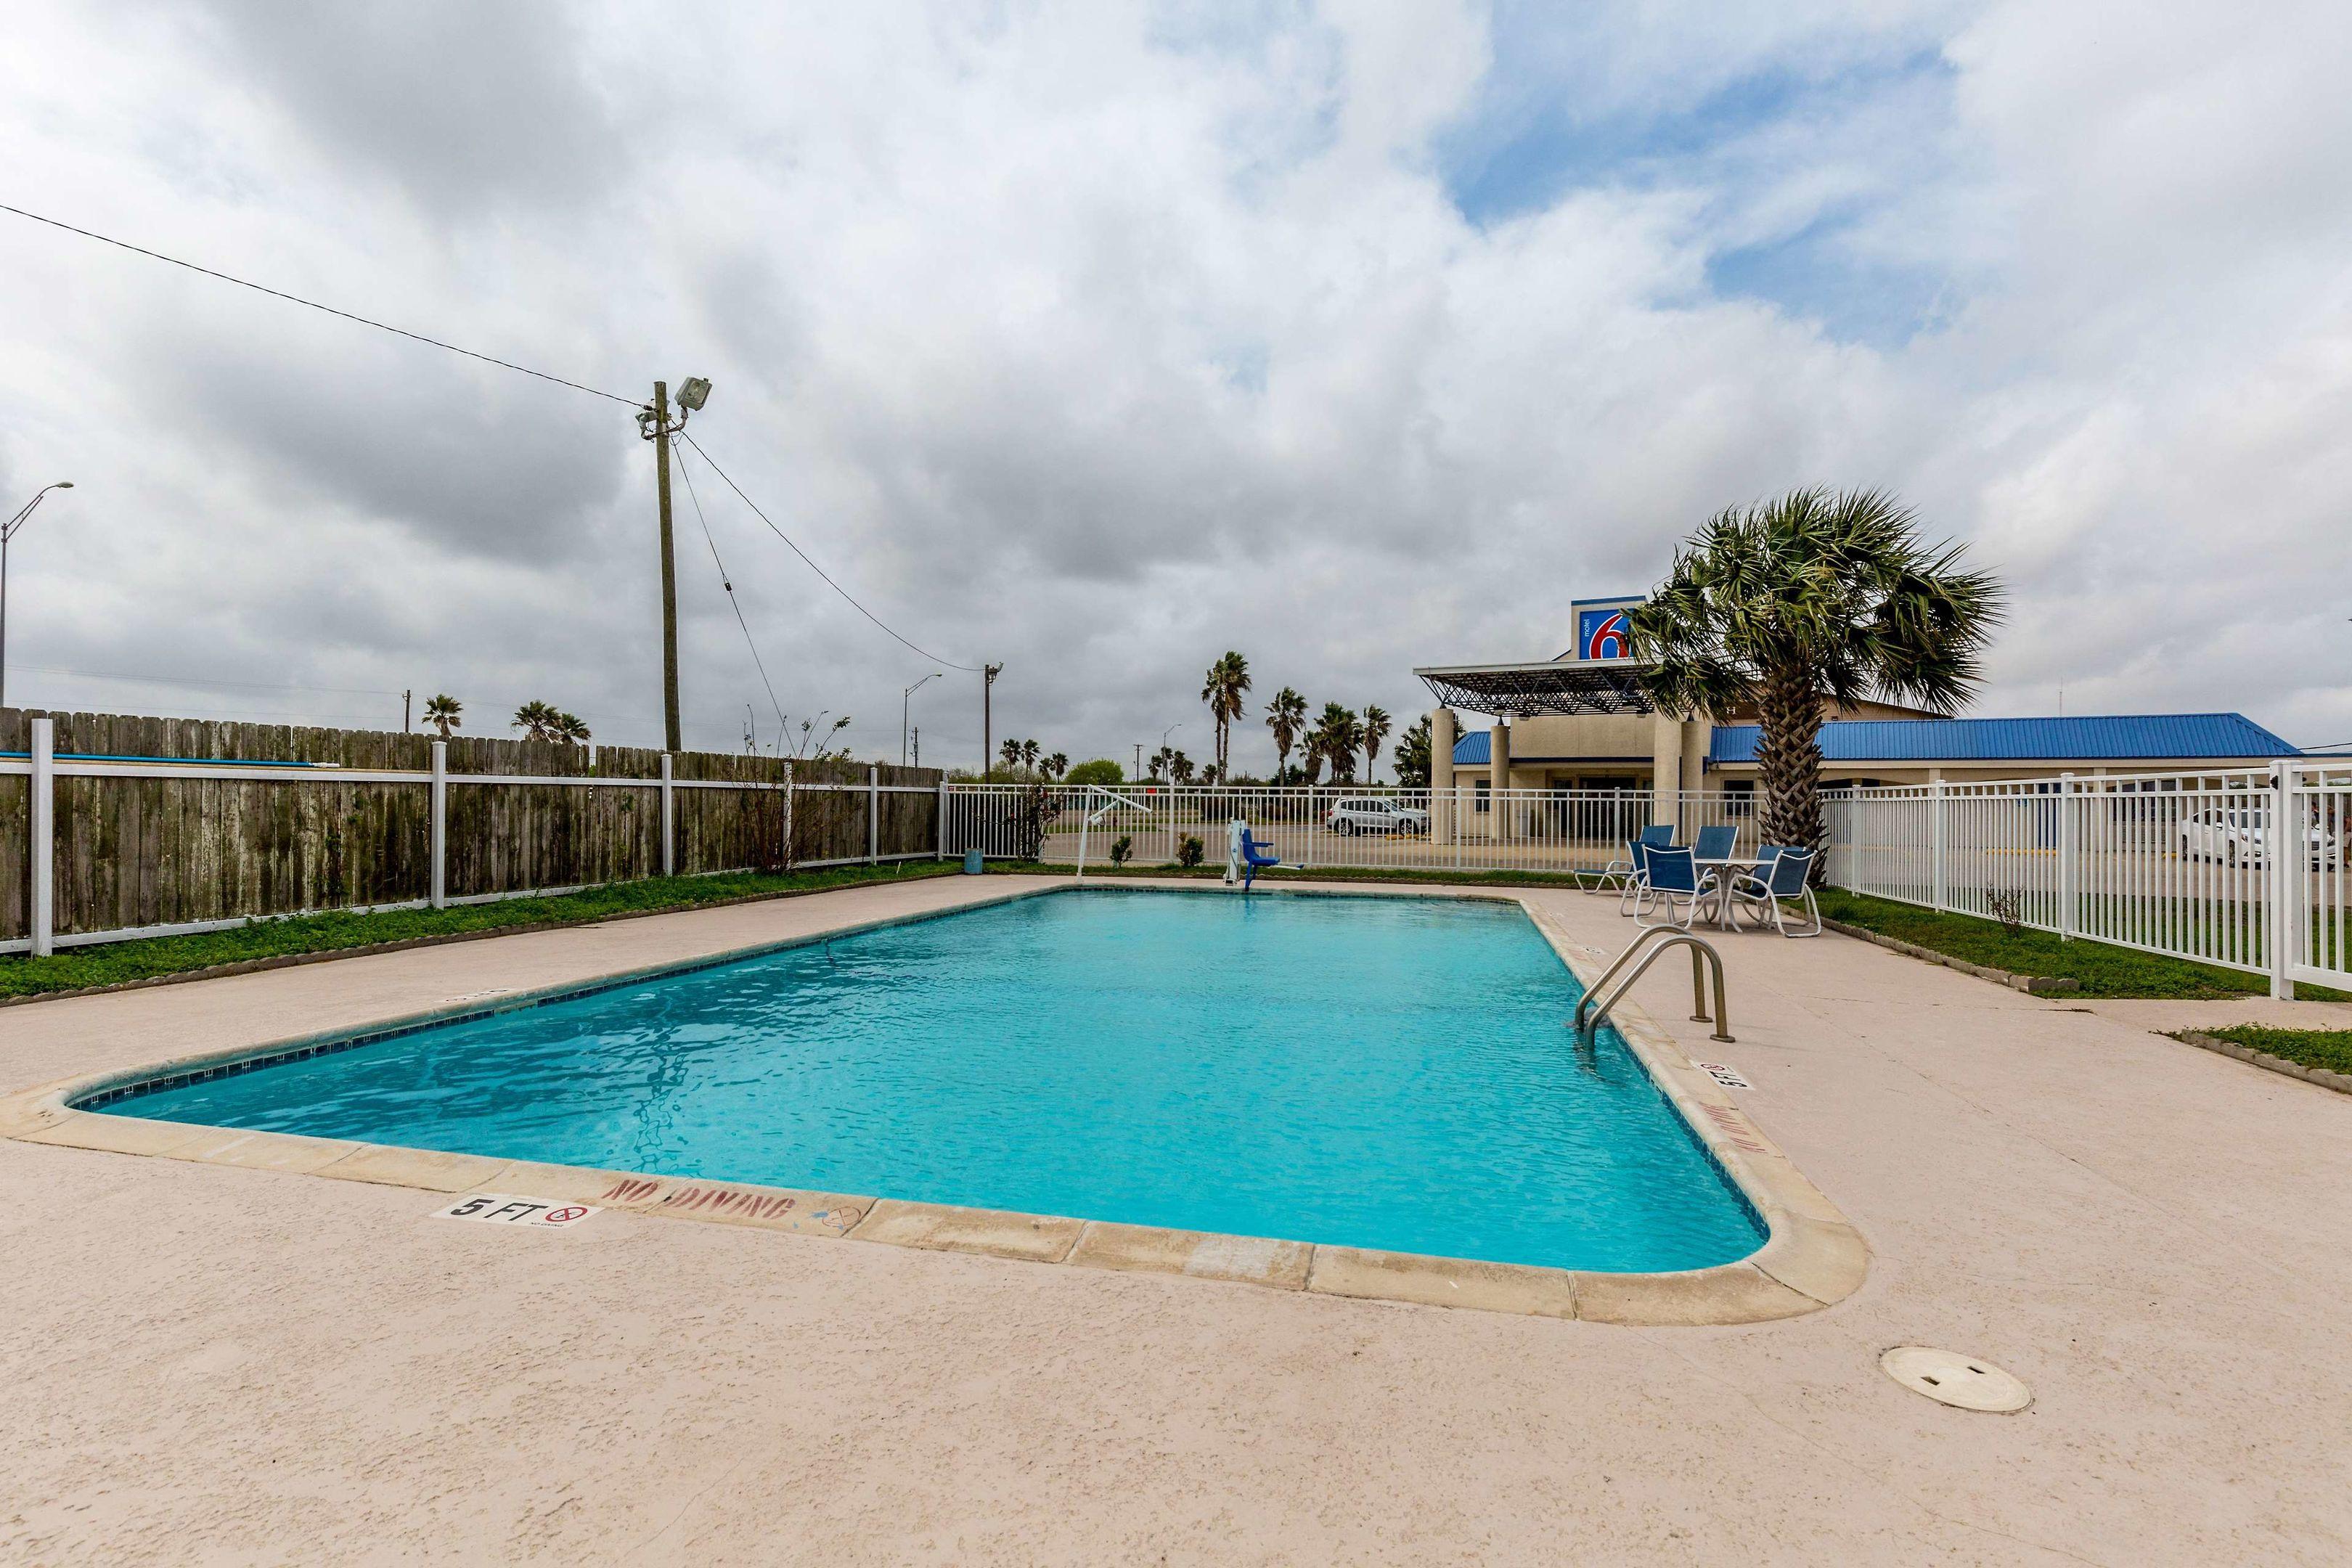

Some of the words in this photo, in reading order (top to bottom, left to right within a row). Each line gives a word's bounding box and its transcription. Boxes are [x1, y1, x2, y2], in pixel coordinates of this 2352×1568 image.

[1589, 613, 1631, 659] 6
[1709, 1071, 1741, 1081] FT
[450, 1199, 495, 1216] 5
[483, 1202, 549, 1222] FT
[600, 1179, 659, 1203] NO
[663, 1187, 796, 1220] DIVING
